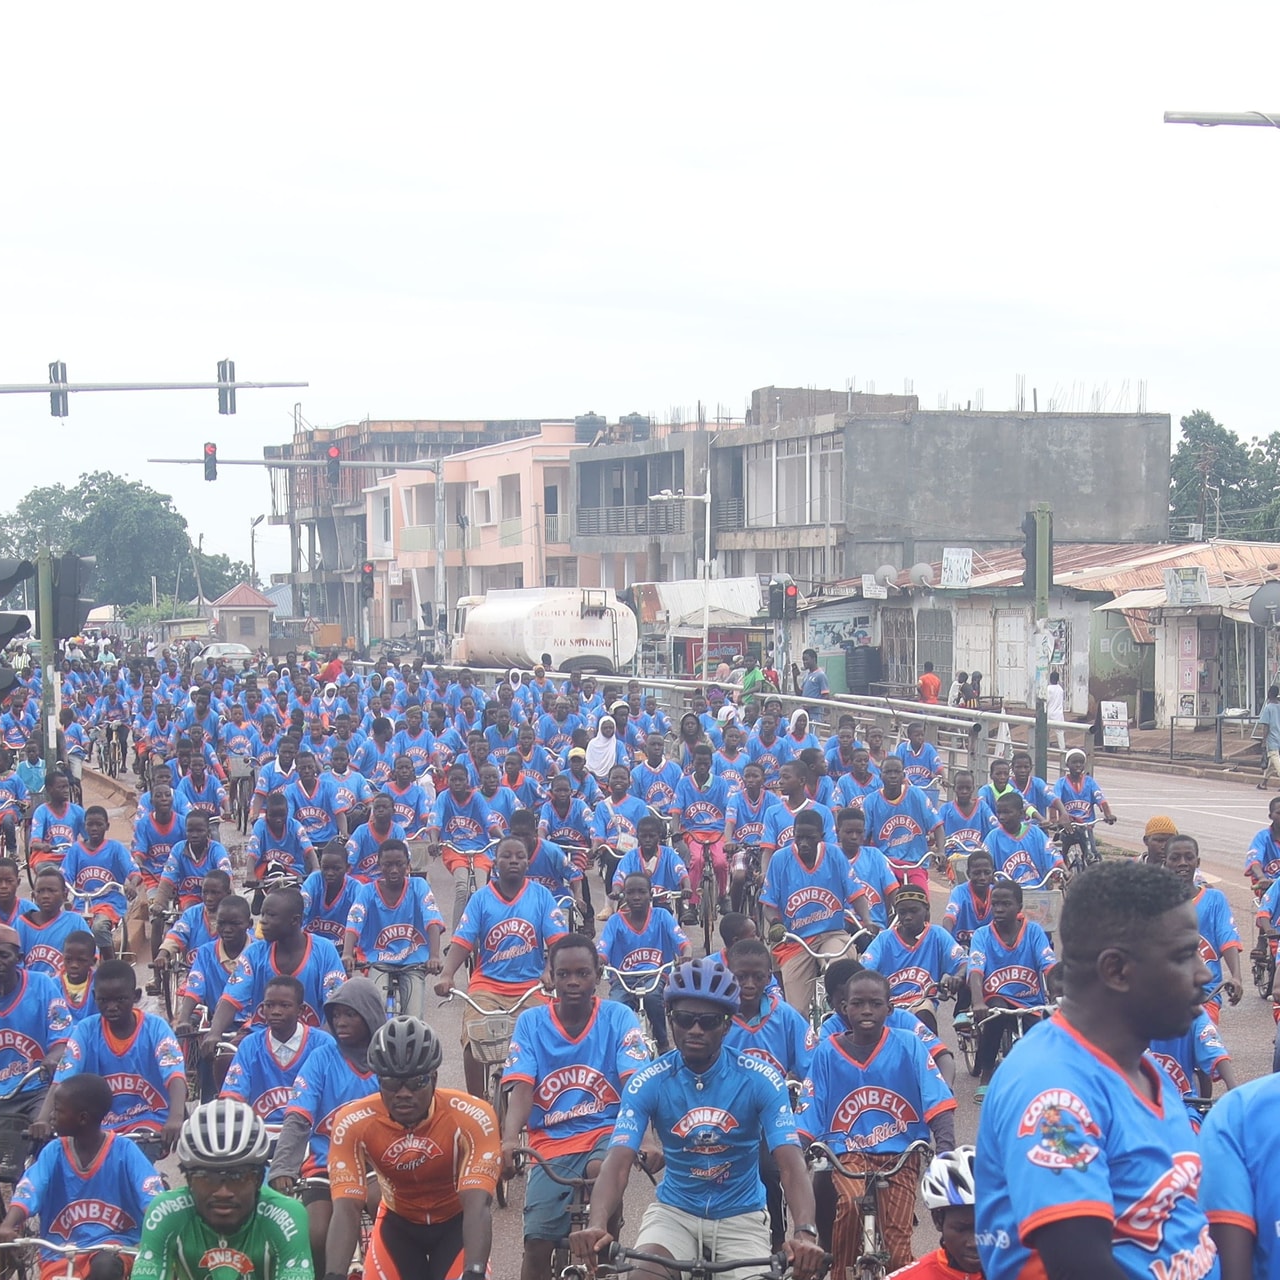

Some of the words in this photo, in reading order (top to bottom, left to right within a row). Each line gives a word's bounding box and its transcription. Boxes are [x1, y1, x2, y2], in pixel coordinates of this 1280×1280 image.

[554, 639, 566, 647] NO
[569, 639, 611, 647] SMOKING
[882, 816, 921, 836] COWBELL
[786, 889, 836, 913] COWBELL
[487, 920, 535, 945] COWBELL
[983, 968, 1039, 993] COWBELL
[539, 1069, 607, 1101] COWBELL
[627, 1059, 672, 1095] COWBELL
[737, 1055, 786, 1092] COWBELL
[450, 1097, 495, 1136] COWBELL
[838, 1090, 907, 1124] COWBELL
[1024, 1090, 1094, 1128] COWBELL
[333, 1107, 376, 1145] COWBELL
[680, 1110, 728, 1132] COWBELL
[387, 1136, 434, 1158] COWBELL
[396, 1155, 426, 1171] Coffee
[60, 1202, 125, 1228] COWBELL
[257, 1201, 299, 1242] COWBELL
